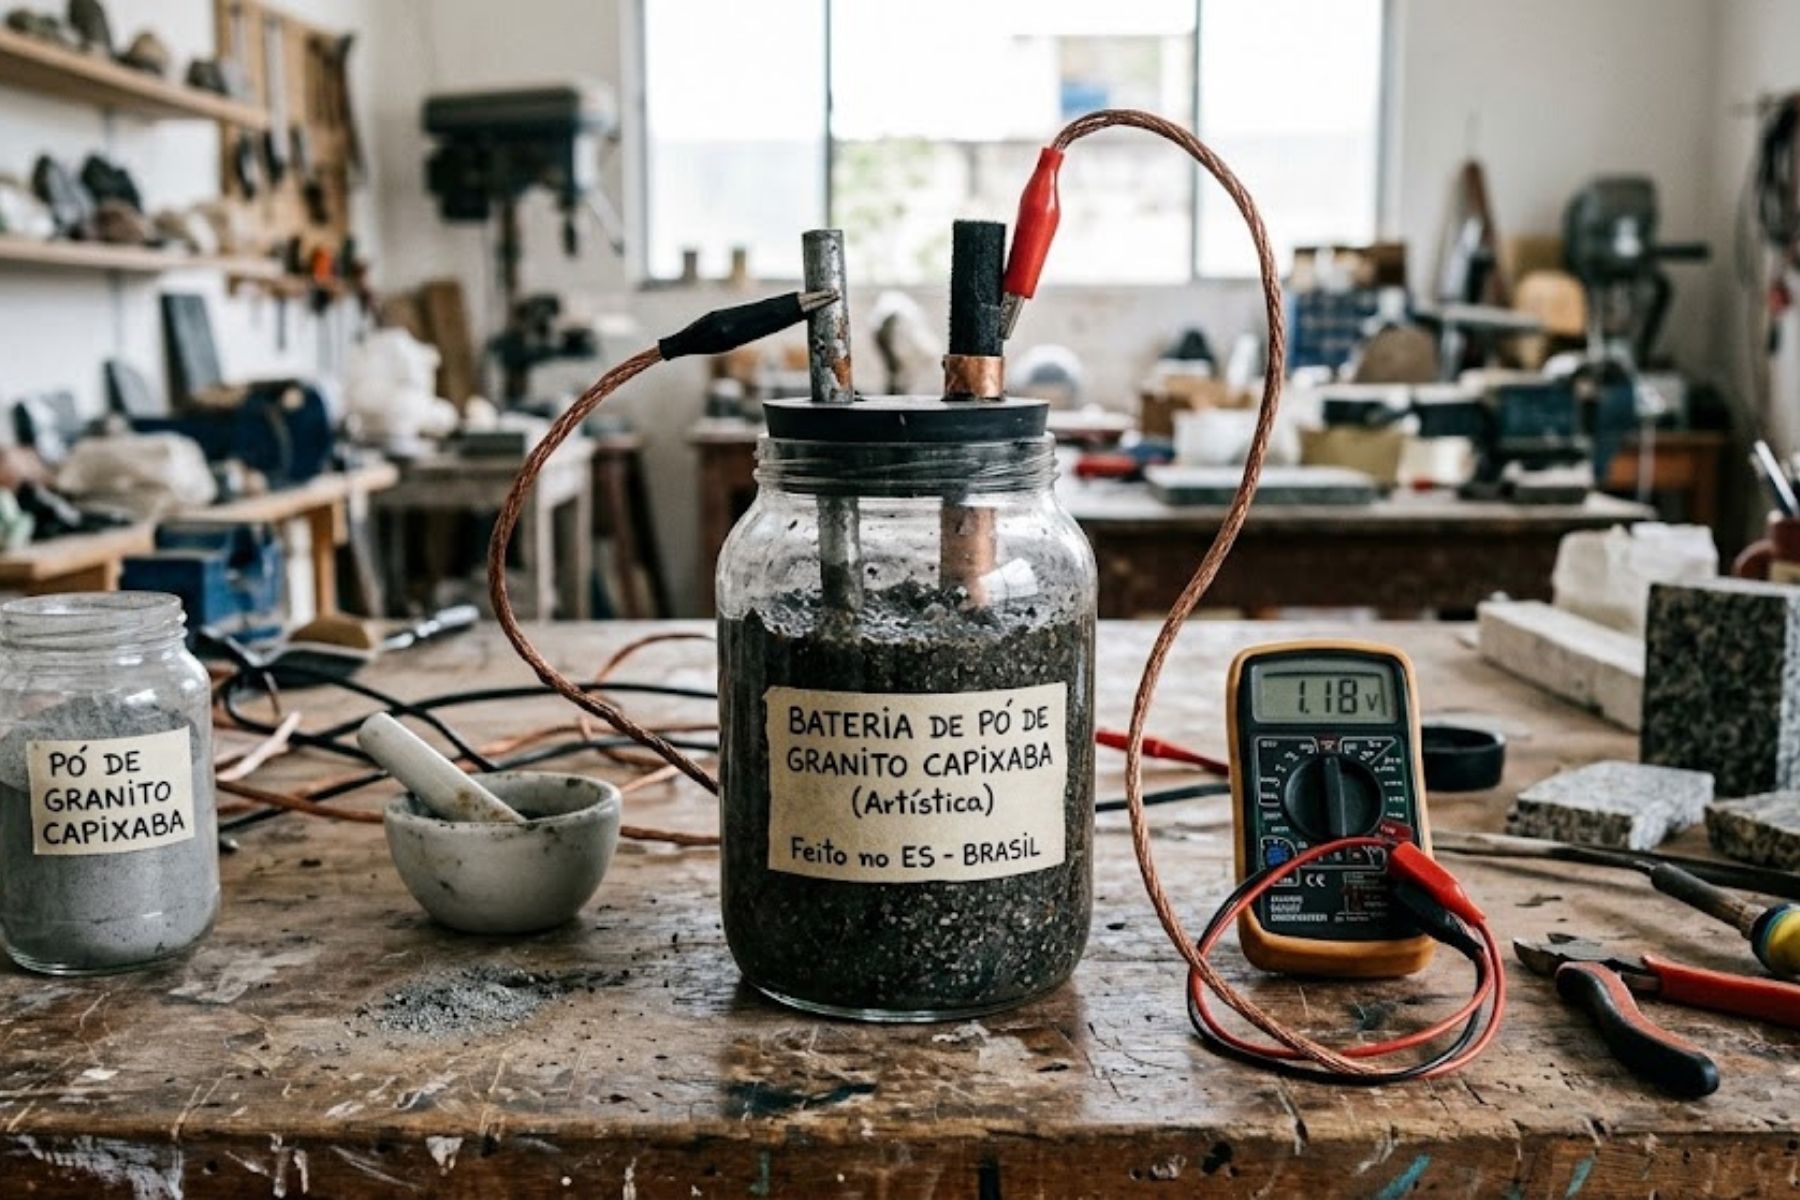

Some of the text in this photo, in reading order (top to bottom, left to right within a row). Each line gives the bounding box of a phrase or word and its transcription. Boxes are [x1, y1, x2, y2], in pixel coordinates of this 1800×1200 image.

[1299, 680, 1357, 715] 1.18
[929, 714, 964, 739] DE
[978, 698, 1012, 735] PÓ
[1022, 705, 1050, 732] DE
[49, 744, 141, 777] PÓ DE
[851, 783, 995, 819] (Artística)
[791, 836, 848, 867] Feito
[858, 852, 890, 868] no
[902, 844, 936, 868] ES
